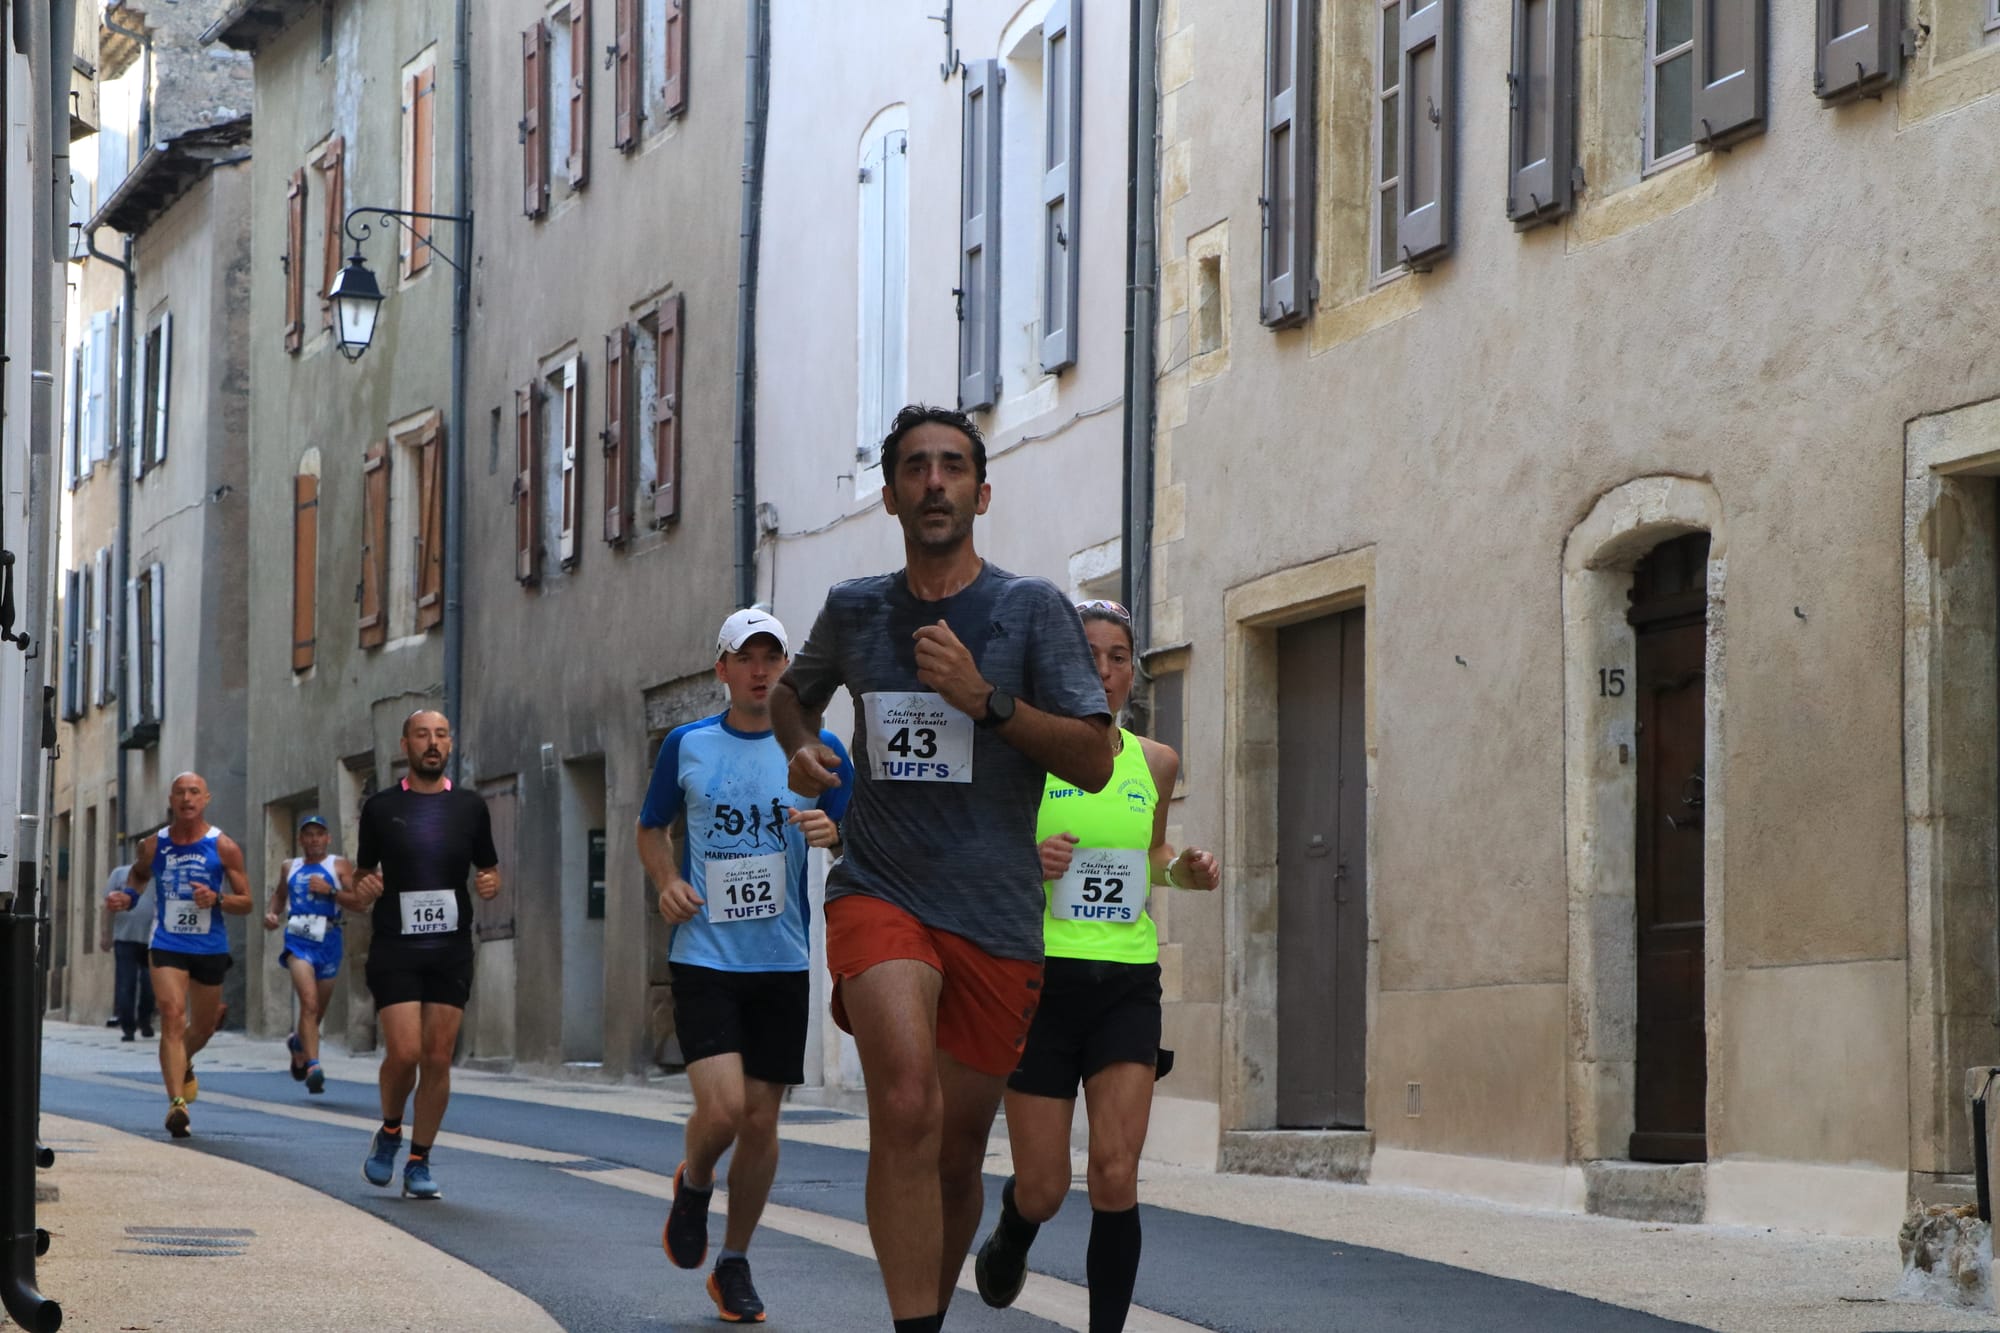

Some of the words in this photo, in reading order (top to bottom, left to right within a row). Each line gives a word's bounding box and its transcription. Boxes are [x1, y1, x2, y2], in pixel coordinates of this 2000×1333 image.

[1599, 668, 1625, 697] 15
[883, 717, 909, 725] vallées
[913, 717, 948, 727] cévenoles
[887, 709, 926, 720] Challenge
[930, 711, 945, 719] des
[887, 727, 938, 759] 43
[882, 761, 950, 778] TUFF'S
[1049, 788, 1084, 799] TUFF'S
[714, 804, 745, 836] 50
[726, 881, 772, 905] 162
[1082, 876, 1124, 904] 52
[413, 906, 445, 922] 164
[723, 903, 777, 919] TUFF'S
[1071, 904, 1131, 920] TUFF'S
[177, 913, 198, 926] 28
[411, 922, 448, 932] TUFF'S
